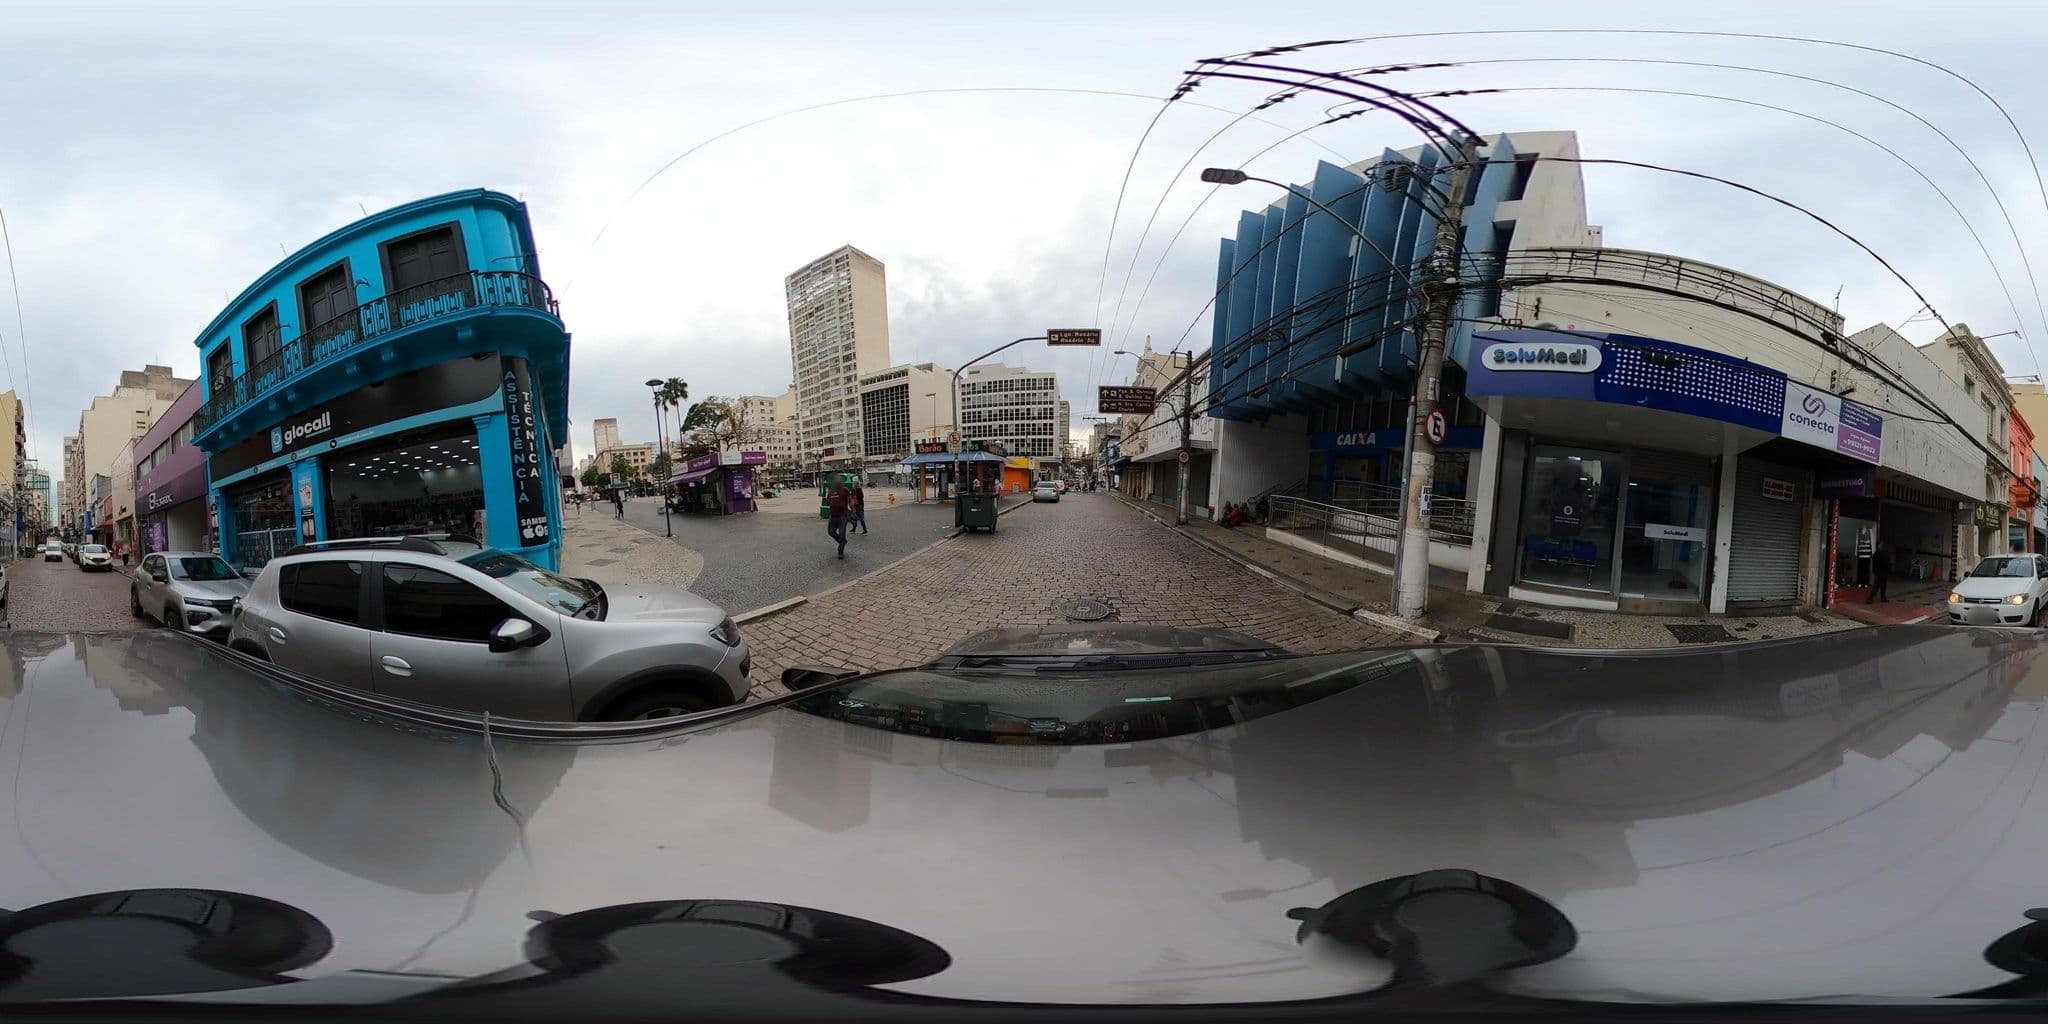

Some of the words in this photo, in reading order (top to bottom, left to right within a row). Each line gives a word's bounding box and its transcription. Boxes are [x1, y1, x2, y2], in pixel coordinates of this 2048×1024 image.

[1493, 348, 1588, 366] SoluMedi
[284, 411, 332, 446] glocall
[1789, 412, 1835, 434] conecta
[504, 370, 530, 503] ASSISTÊNCIA
[522, 391, 540, 478] TÉCNICA
[1336, 432, 1376, 447] CAIXA
[918, 444, 943, 453] Barão
